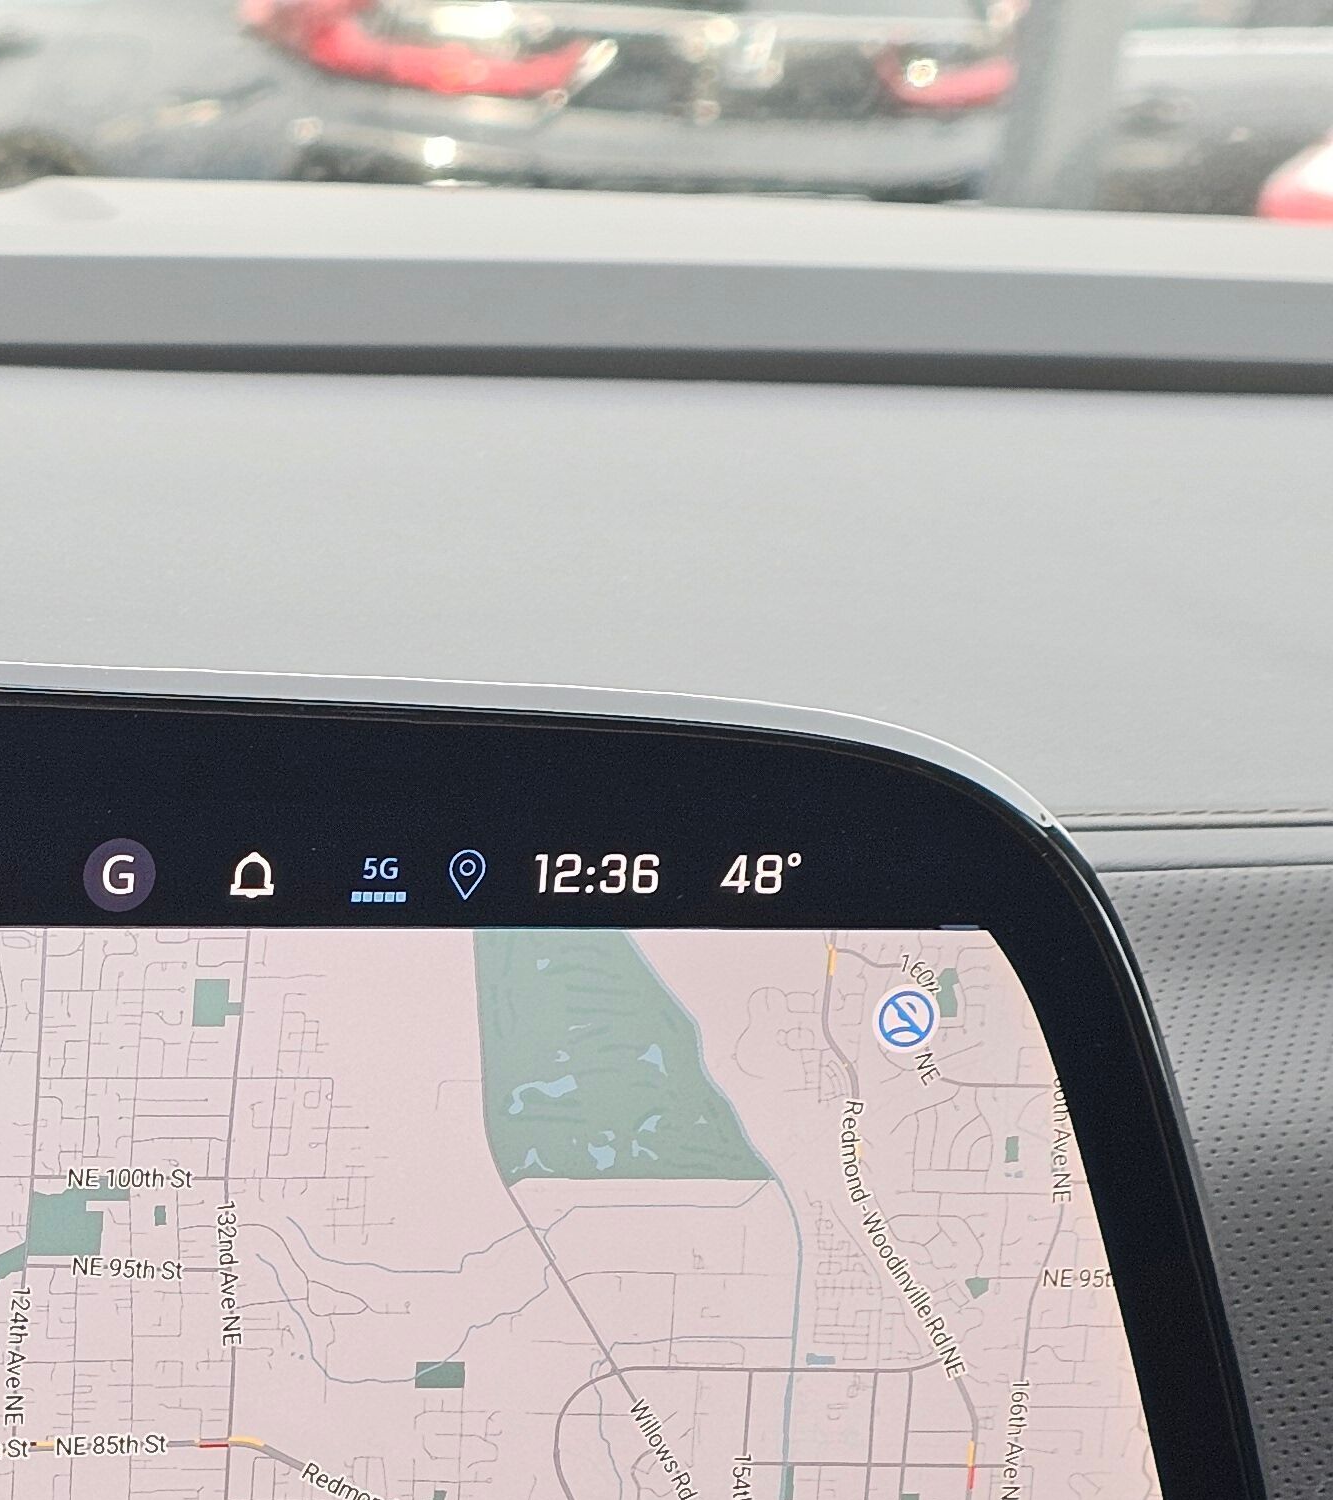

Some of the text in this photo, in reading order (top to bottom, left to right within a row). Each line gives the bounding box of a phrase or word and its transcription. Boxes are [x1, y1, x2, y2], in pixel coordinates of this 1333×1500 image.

[102, 855, 136, 896] G
[363, 858, 399, 882] 5G
[535, 853, 660, 894] 12:36
[915, 1052, 942, 1086] NE
[1053, 1129, 1071, 1168] Ave
[67, 1169, 192, 1189] NE 100th St
[1052, 1173, 1071, 1203] NE
[841, 1100, 868, 1202] Redmond
[863, 1212, 933, 1318] Woodinville
[926, 1316, 953, 1348] Rd
[940, 1346, 966, 1379] NE
[71, 1258, 183, 1280] NE 95th St
[218, 1201, 242, 1345] 132nd Ave NE
[1043, 1269, 1115, 1288] NE 95t
[4, 1288, 31, 1425] 124th Ave NE
[1008, 1380, 1029, 1438] 166th
[2, 1439, 28, 1458] St
[56, 1436, 166, 1455] NE 85th St
[630, 1399, 677, 1474] Willows
[670, 1469, 697, 1500] Rd
[1003, 1441, 1026, 1480] Ave
